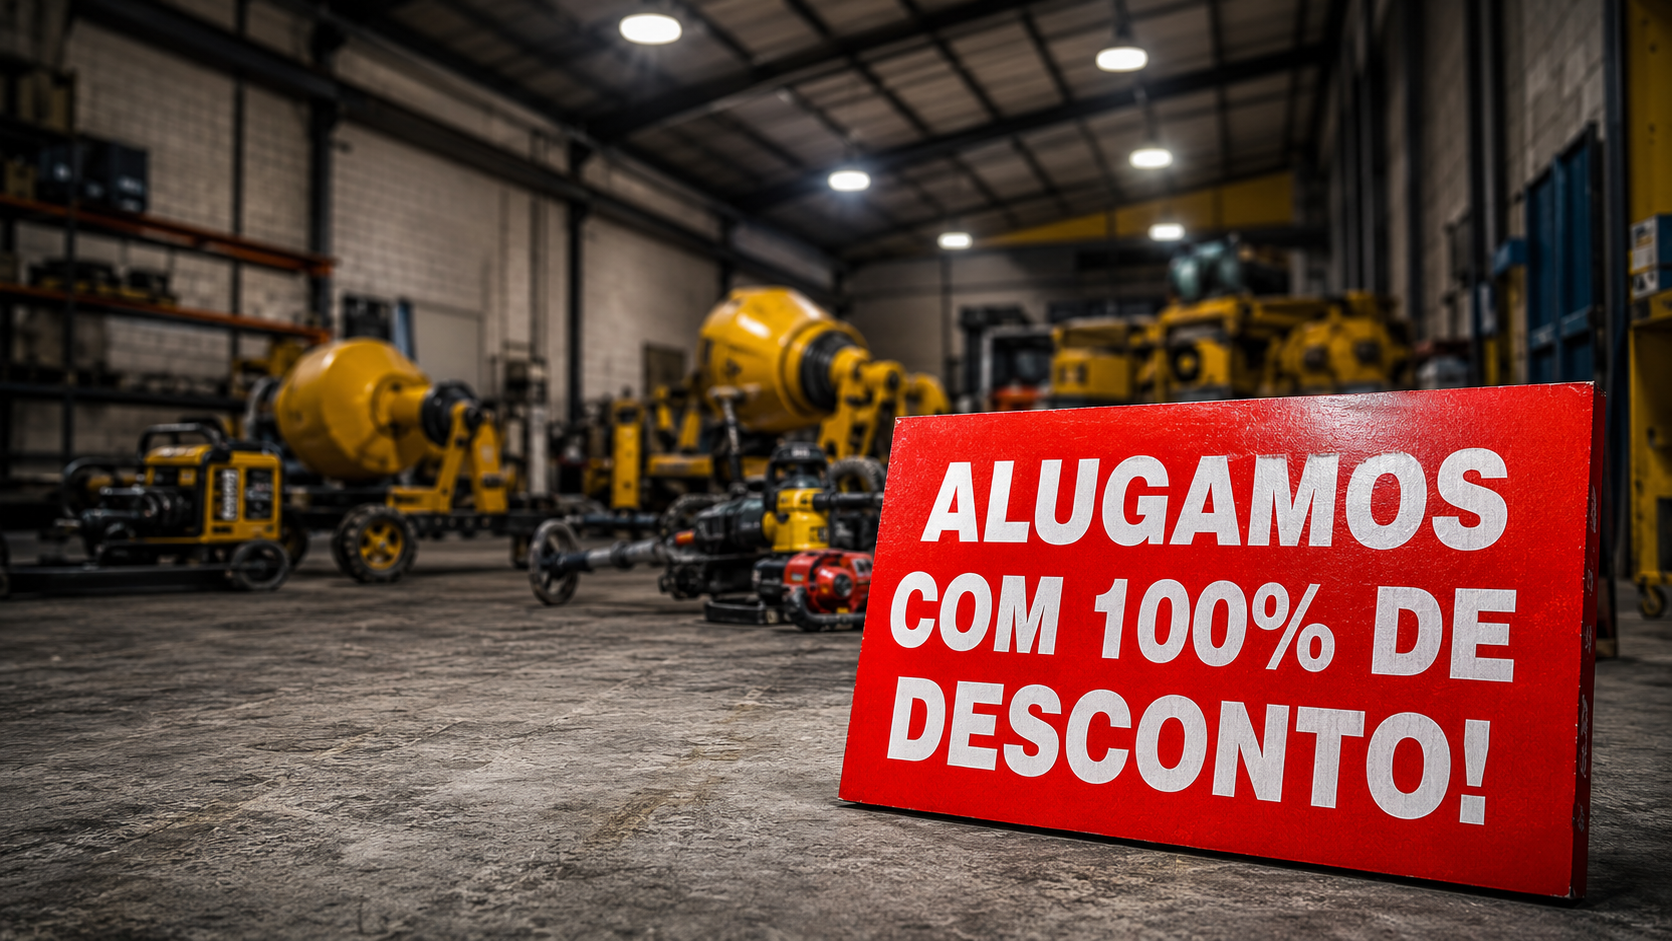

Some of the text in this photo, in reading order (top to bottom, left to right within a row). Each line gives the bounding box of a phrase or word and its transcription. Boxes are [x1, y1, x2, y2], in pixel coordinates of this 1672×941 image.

[920, 446, 1508, 551] ALUGAMOS
[889, 571, 1517, 683] COM 100% DE
[886, 676, 1491, 826] DESCONTO!
